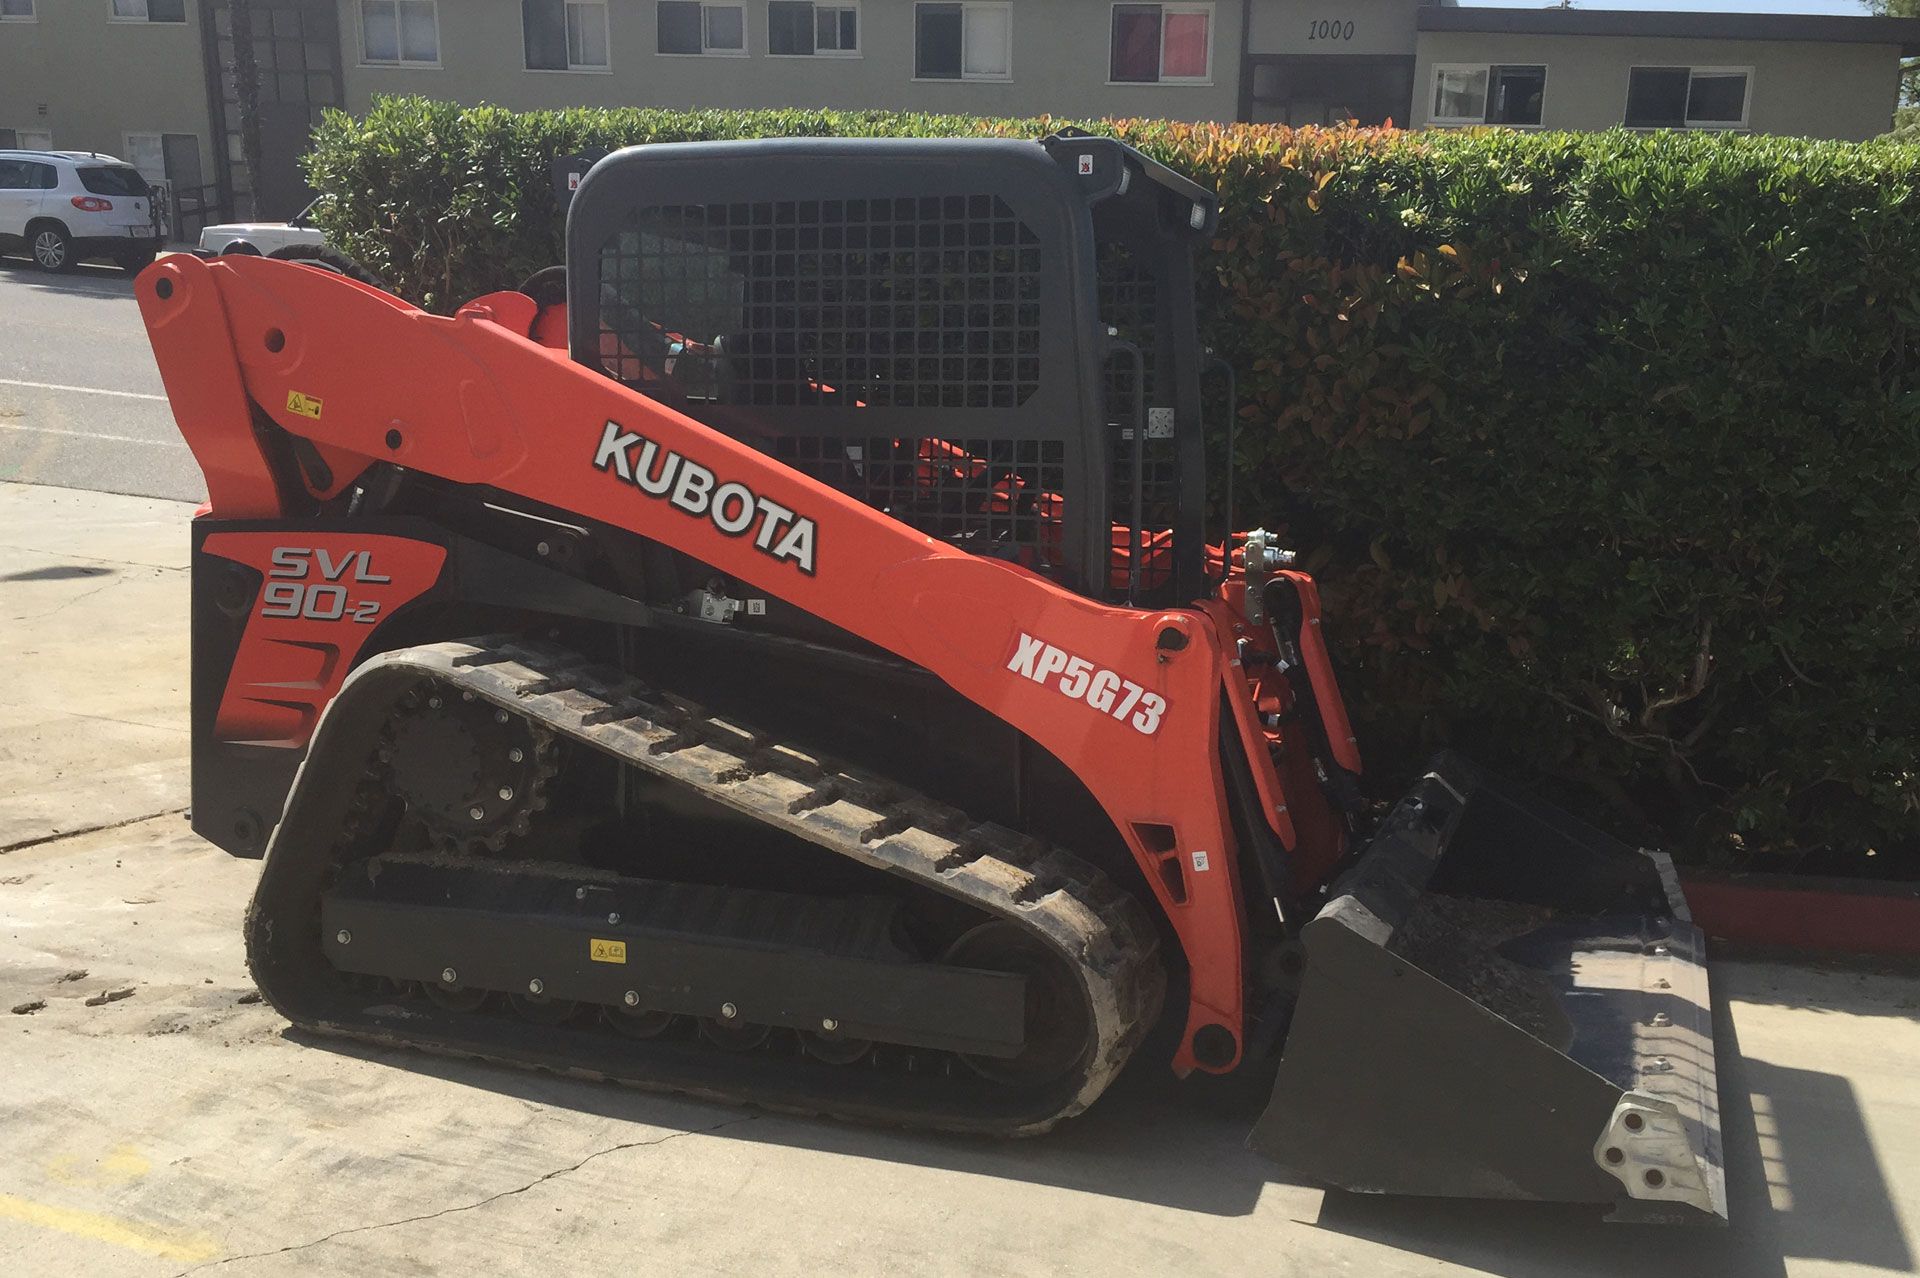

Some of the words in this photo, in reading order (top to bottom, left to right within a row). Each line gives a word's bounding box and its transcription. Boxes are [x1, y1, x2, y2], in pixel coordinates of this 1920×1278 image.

[1308, 20, 1355, 40] 1000
[593, 419, 817, 577] KUBOTA
[269, 546, 392, 585] SVL
[261, 581, 381, 624] 90-2
[1006, 632, 1167, 735] XP5G73
